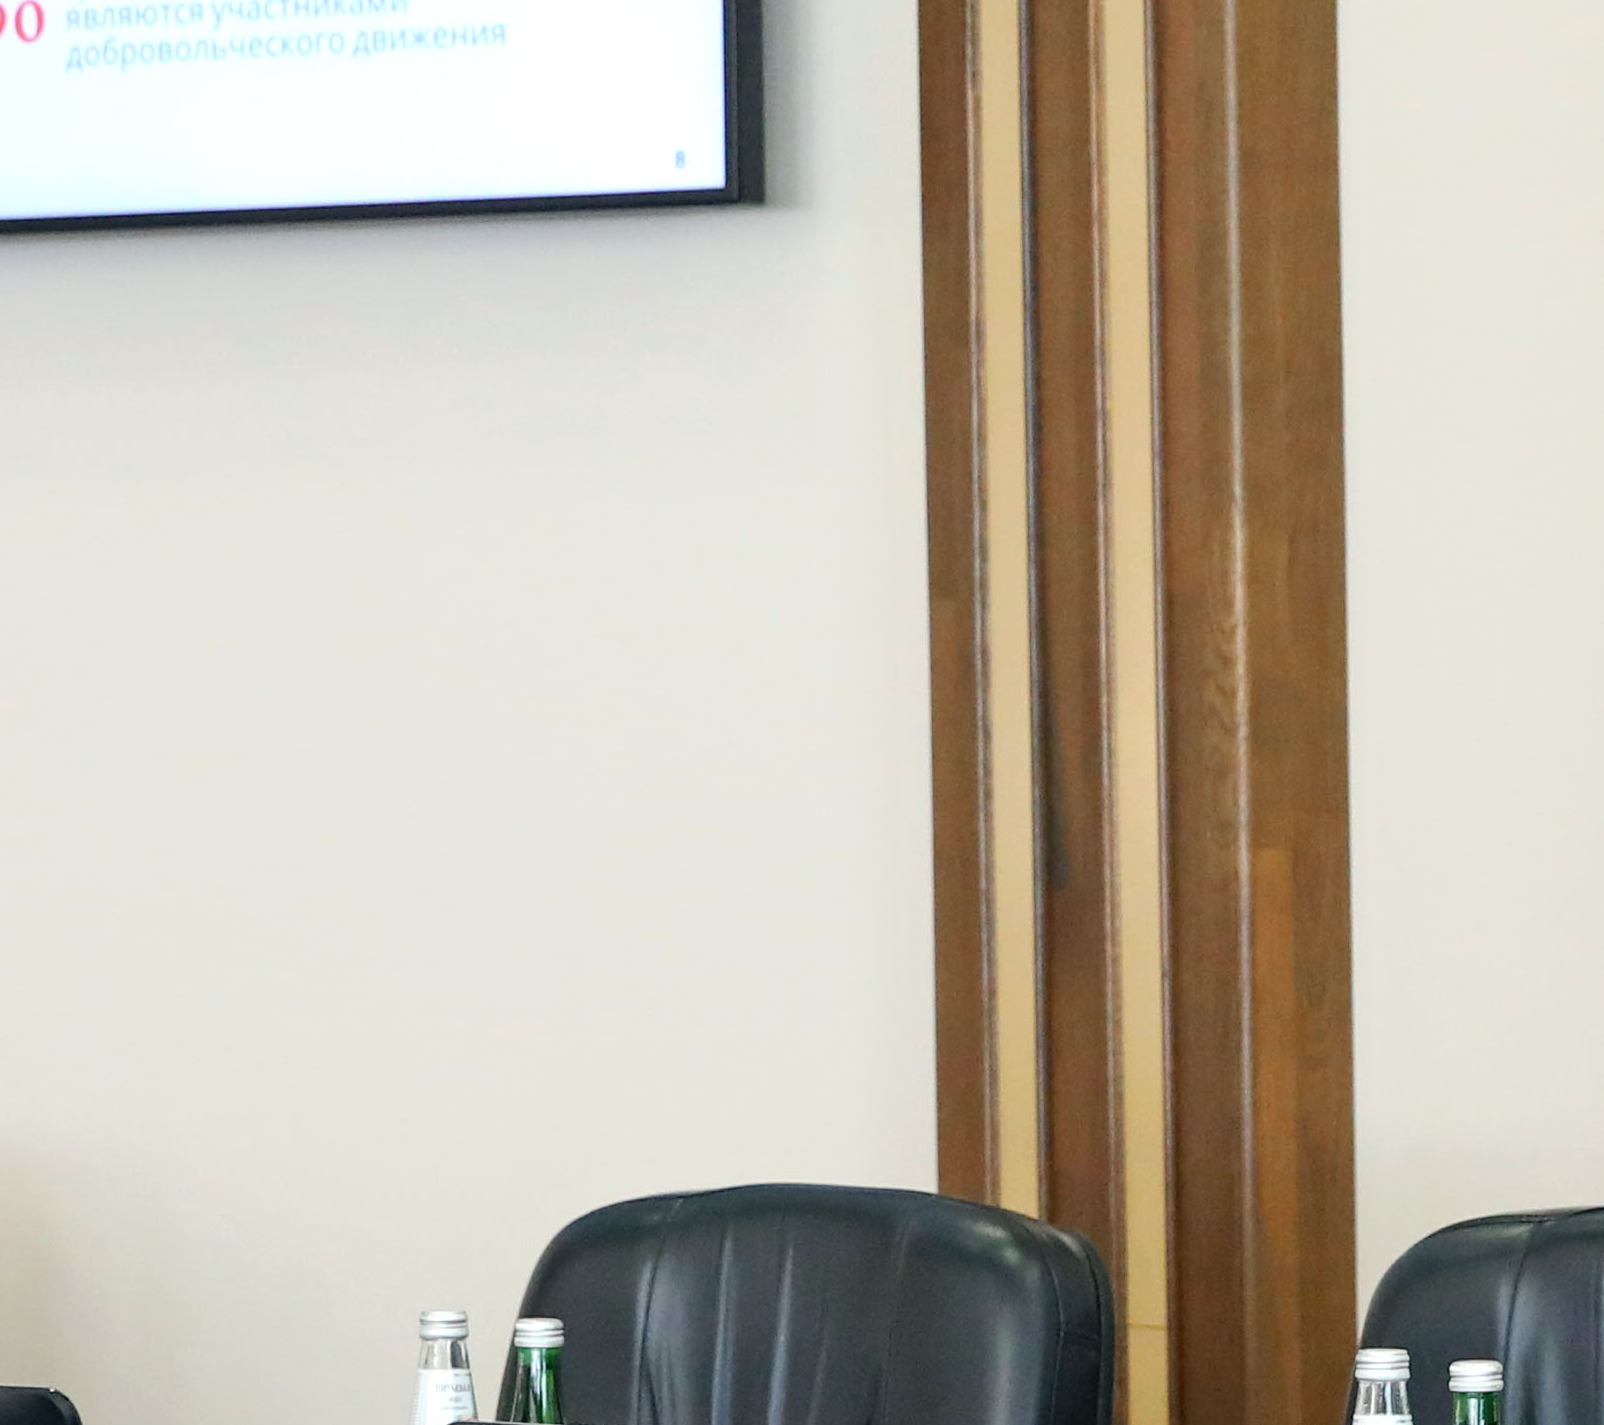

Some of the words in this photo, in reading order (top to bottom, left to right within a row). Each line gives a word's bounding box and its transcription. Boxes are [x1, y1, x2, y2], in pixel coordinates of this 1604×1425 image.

[64, 1, 204, 31] являются
[64, 32, 346, 75] добровольческого
[351, 22, 507, 60] движения
